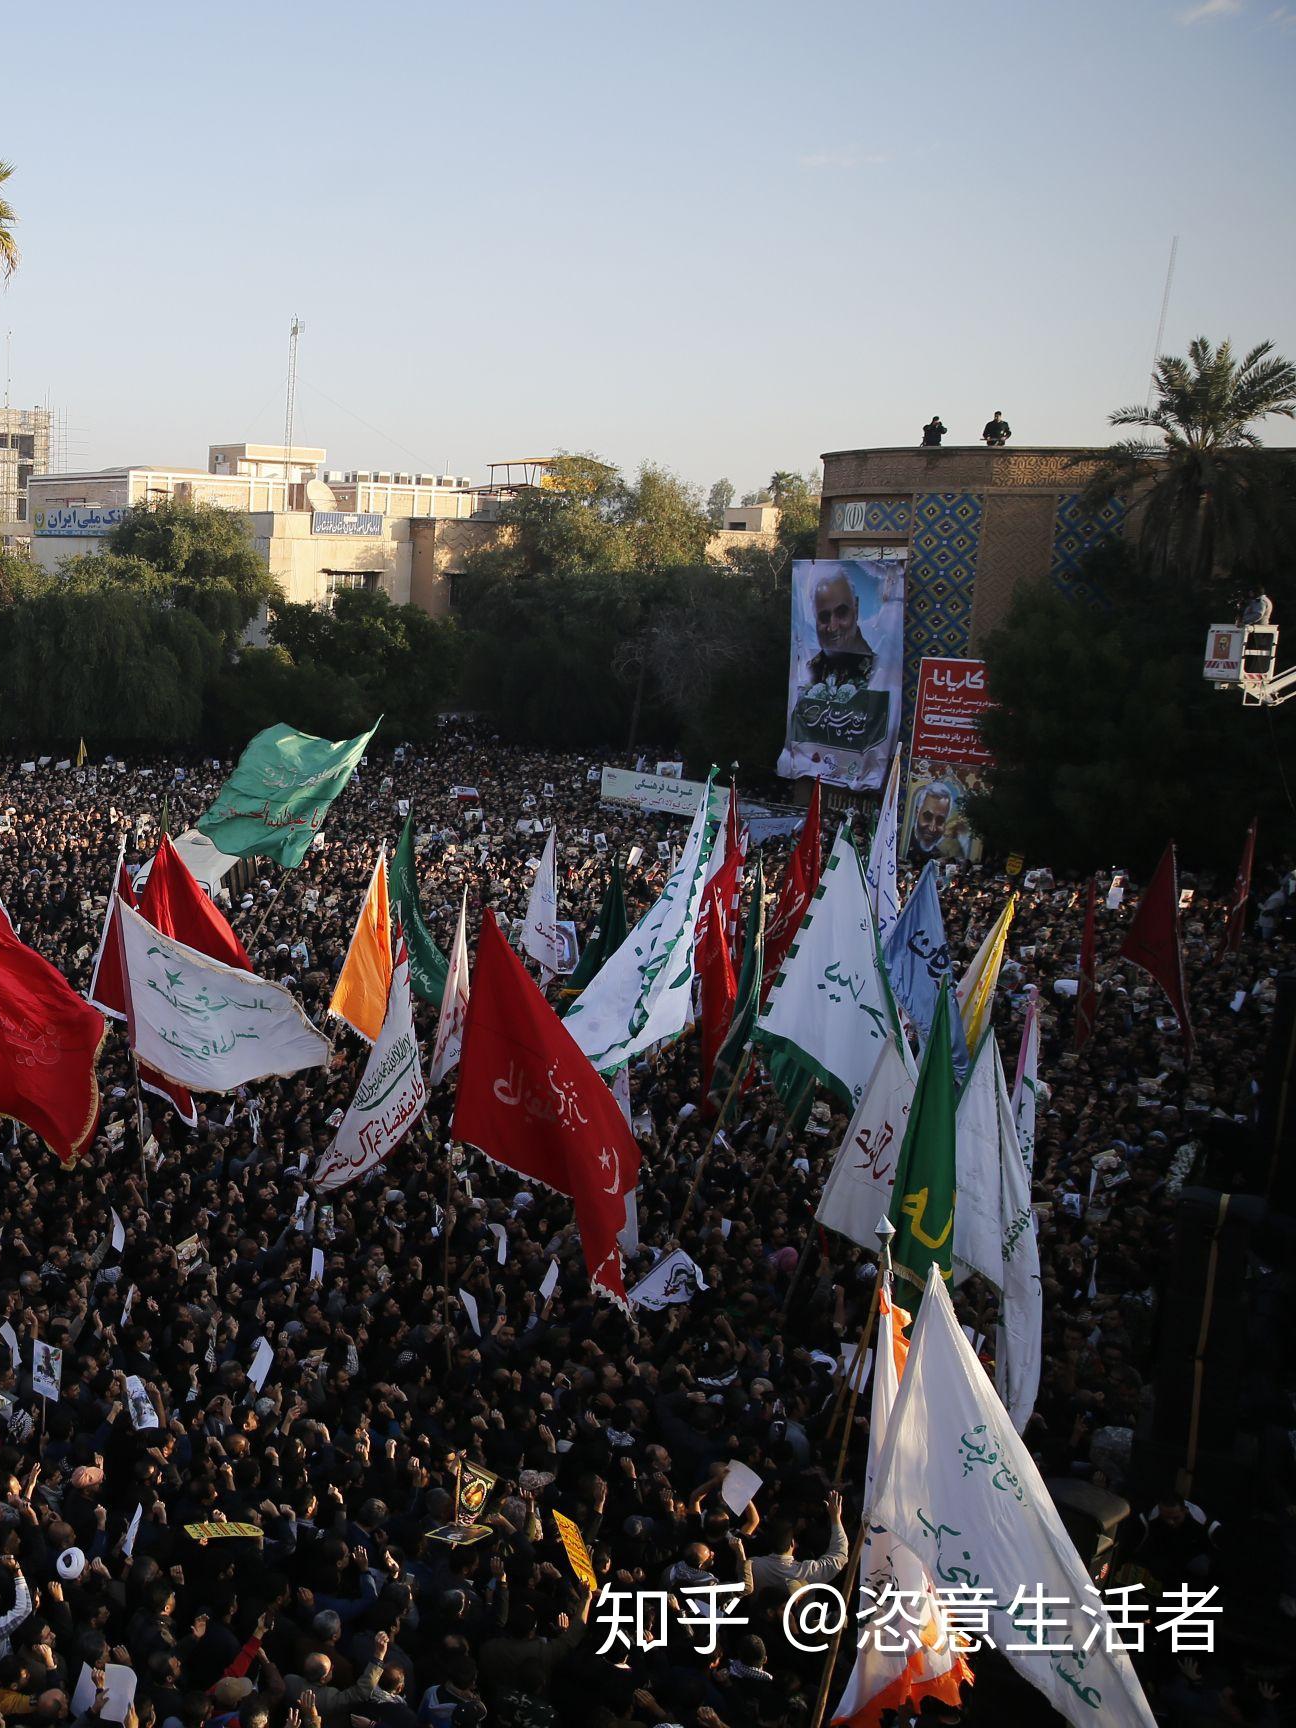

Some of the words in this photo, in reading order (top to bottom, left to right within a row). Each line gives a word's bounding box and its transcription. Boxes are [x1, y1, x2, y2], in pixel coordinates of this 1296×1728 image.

[47, 510, 76, 529] ایران
[77, 510, 100, 528] ملی
[933, 668, 985, 692] کاریانا
[634, 779, 665, 794] فرهنگی
[666, 783, 693, 797] غرفه
